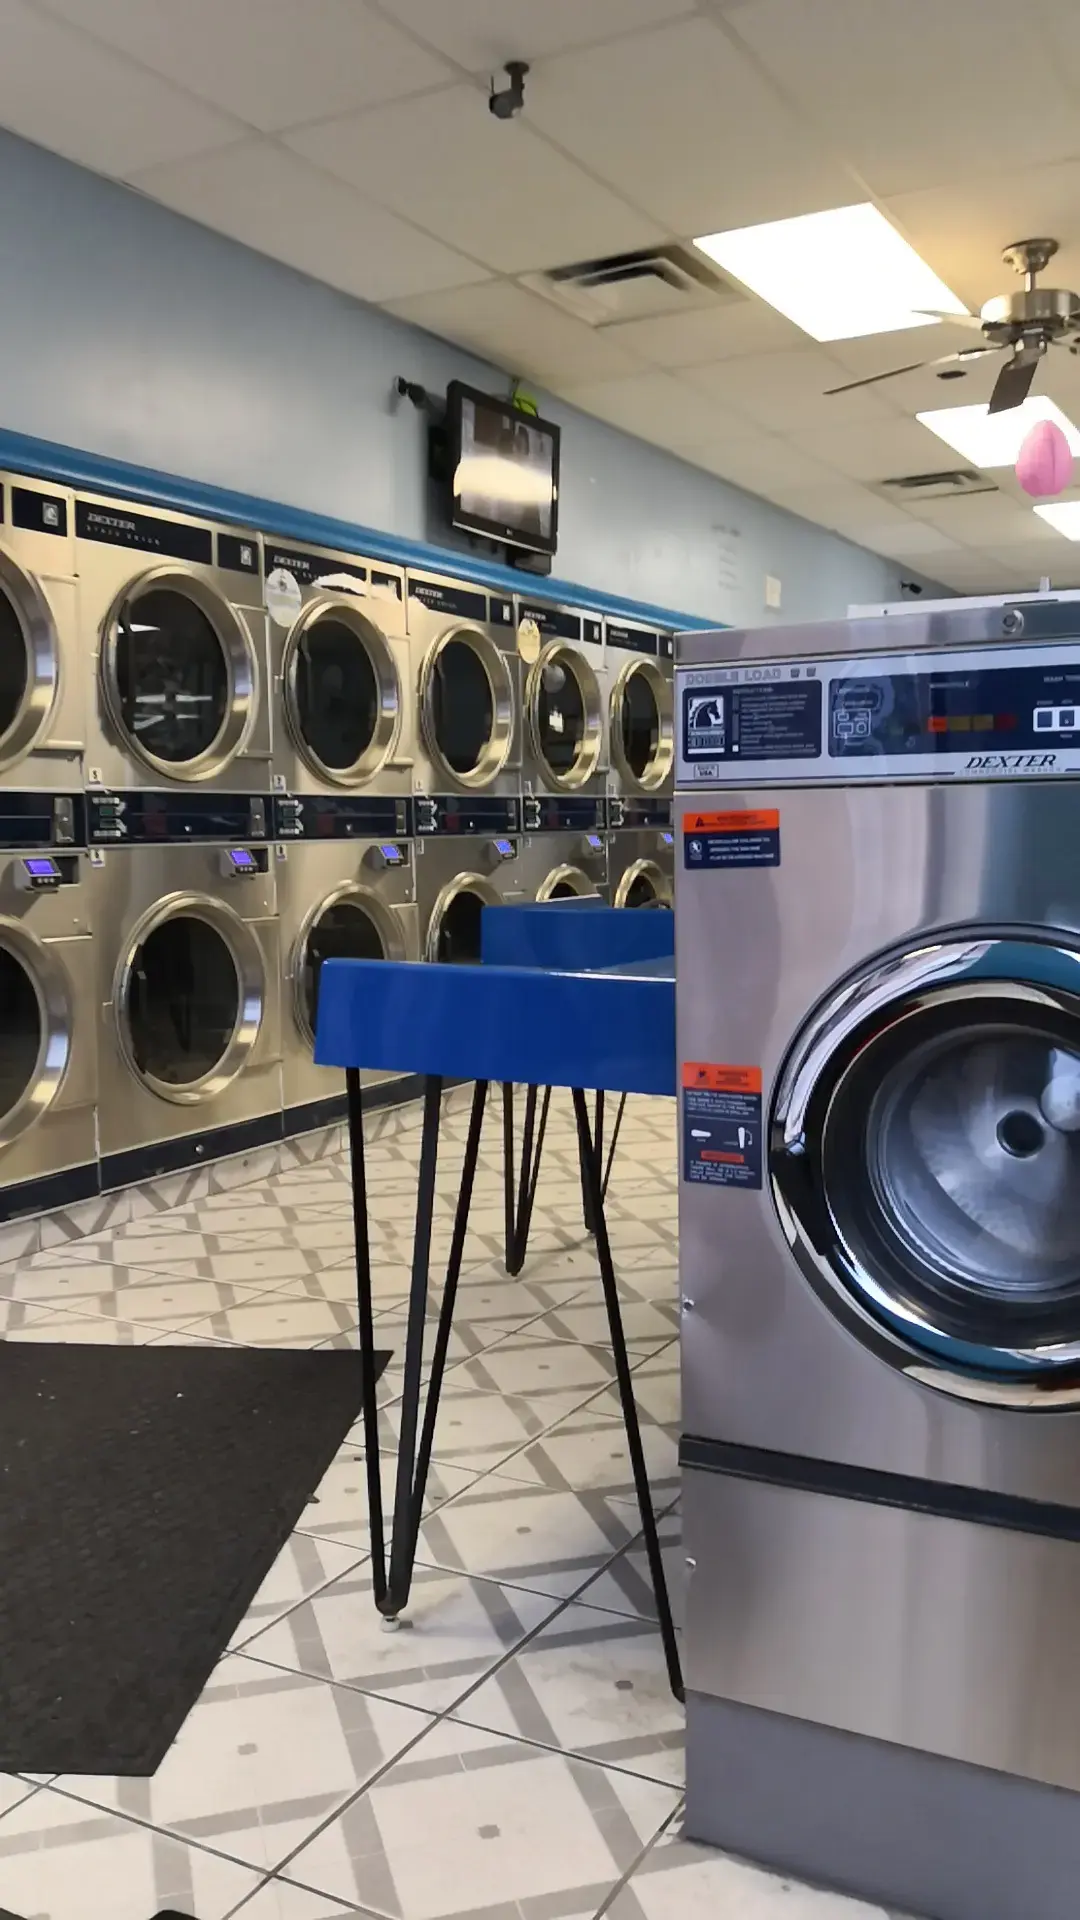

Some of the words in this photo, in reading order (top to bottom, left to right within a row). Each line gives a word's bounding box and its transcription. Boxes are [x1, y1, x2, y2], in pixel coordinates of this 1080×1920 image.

[87, 512, 136, 531] DEXTER
[744, 667, 782, 681] LOAD
[964, 754, 1057, 769] DEXTER
